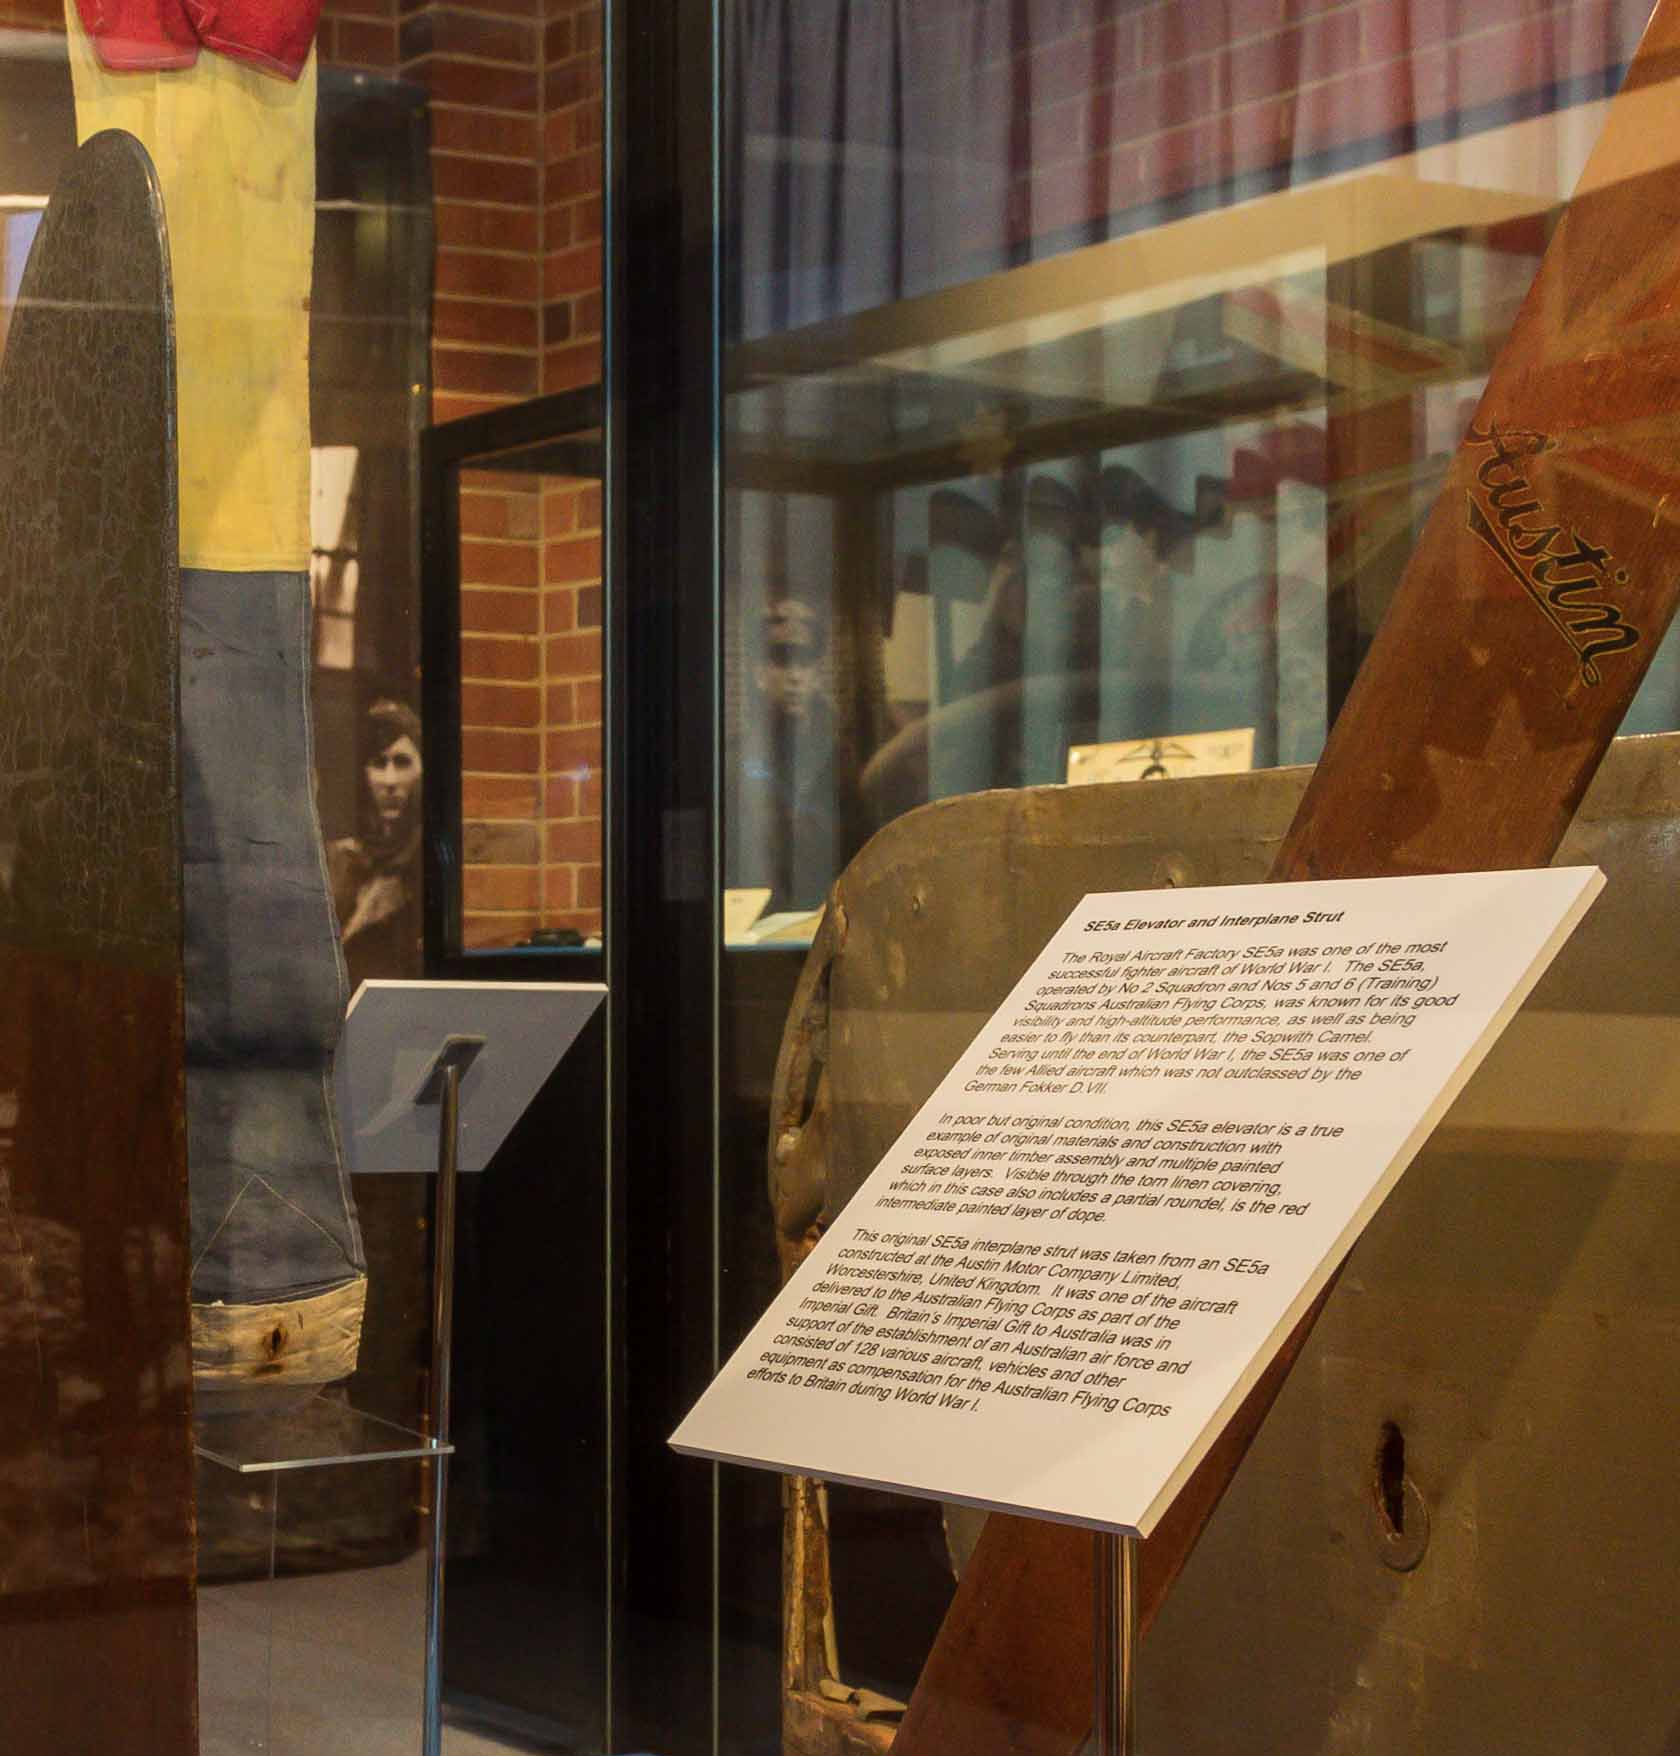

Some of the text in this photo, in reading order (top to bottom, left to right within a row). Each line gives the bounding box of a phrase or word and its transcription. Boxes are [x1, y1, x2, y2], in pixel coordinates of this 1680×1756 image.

[1463, 420, 1641, 680] Austin
[1082, 911, 1345, 932] SE5a Elevator and Interplane Strut
[925, 1130, 1282, 1154] example of original materials and construction with
[938, 1112, 1344, 1137] In poor but original condition, this SE5a elevator is a true
[900, 1162, 1281, 1197] surface layers. Visible through the torn linen covering,
[913, 1147, 1284, 1174] exposed inner timber assembly and multiple painted
[874, 1195, 1105, 1224] intermediate painted layer of dope.
[888, 1178, 1311, 1215] which in this case also includes a partial roundel, is the red
[837, 1248, 1182, 1290] constructed at the Austin Motor Company Limited,
[852, 1227, 1270, 1275] This original SE5a interplane strut was taken from an SE5a
[811, 1280, 1181, 1330] delivered to the Australian Flying Corps as part of the
[825, 1262, 1239, 1314] Worcestershire, United Kingdom. It was one of the aircraft
[798, 1296, 854, 1313] Imperial
[942, 1311, 1004, 1330] Imperial
[1003, 1318, 1031, 1334] Gift
[1031, 1322, 1048, 1336] to
[1047, 1324, 1117, 1344] Australia
[1119, 1335, 1153, 1348] was
[1154, 1336, 1171, 1350] in
[772, 1333, 837, 1349] consisted
[834, 1339, 854, 1351] of
[853, 1341, 880, 1355] 128
[880, 1347, 930, 1363] various
[988, 1360, 1048, 1378] vehicles
[1049, 1368, 1084, 1382] and
[1082, 1371, 1127, 1387] other
[785, 1316, 1192, 1374] support of the establishment of an Australian air force and
[746, 1367, 787, 1383] efforts
[787, 1372, 802, 1385] to
[802, 1374, 847, 1392] Britain
[847, 1380, 892, 1401] during
[893, 1386, 939, 1405] World
[937, 1392, 971, 1409] War
[759, 1351, 1172, 1418] equipment as compensation for the Australian Flying Corps
